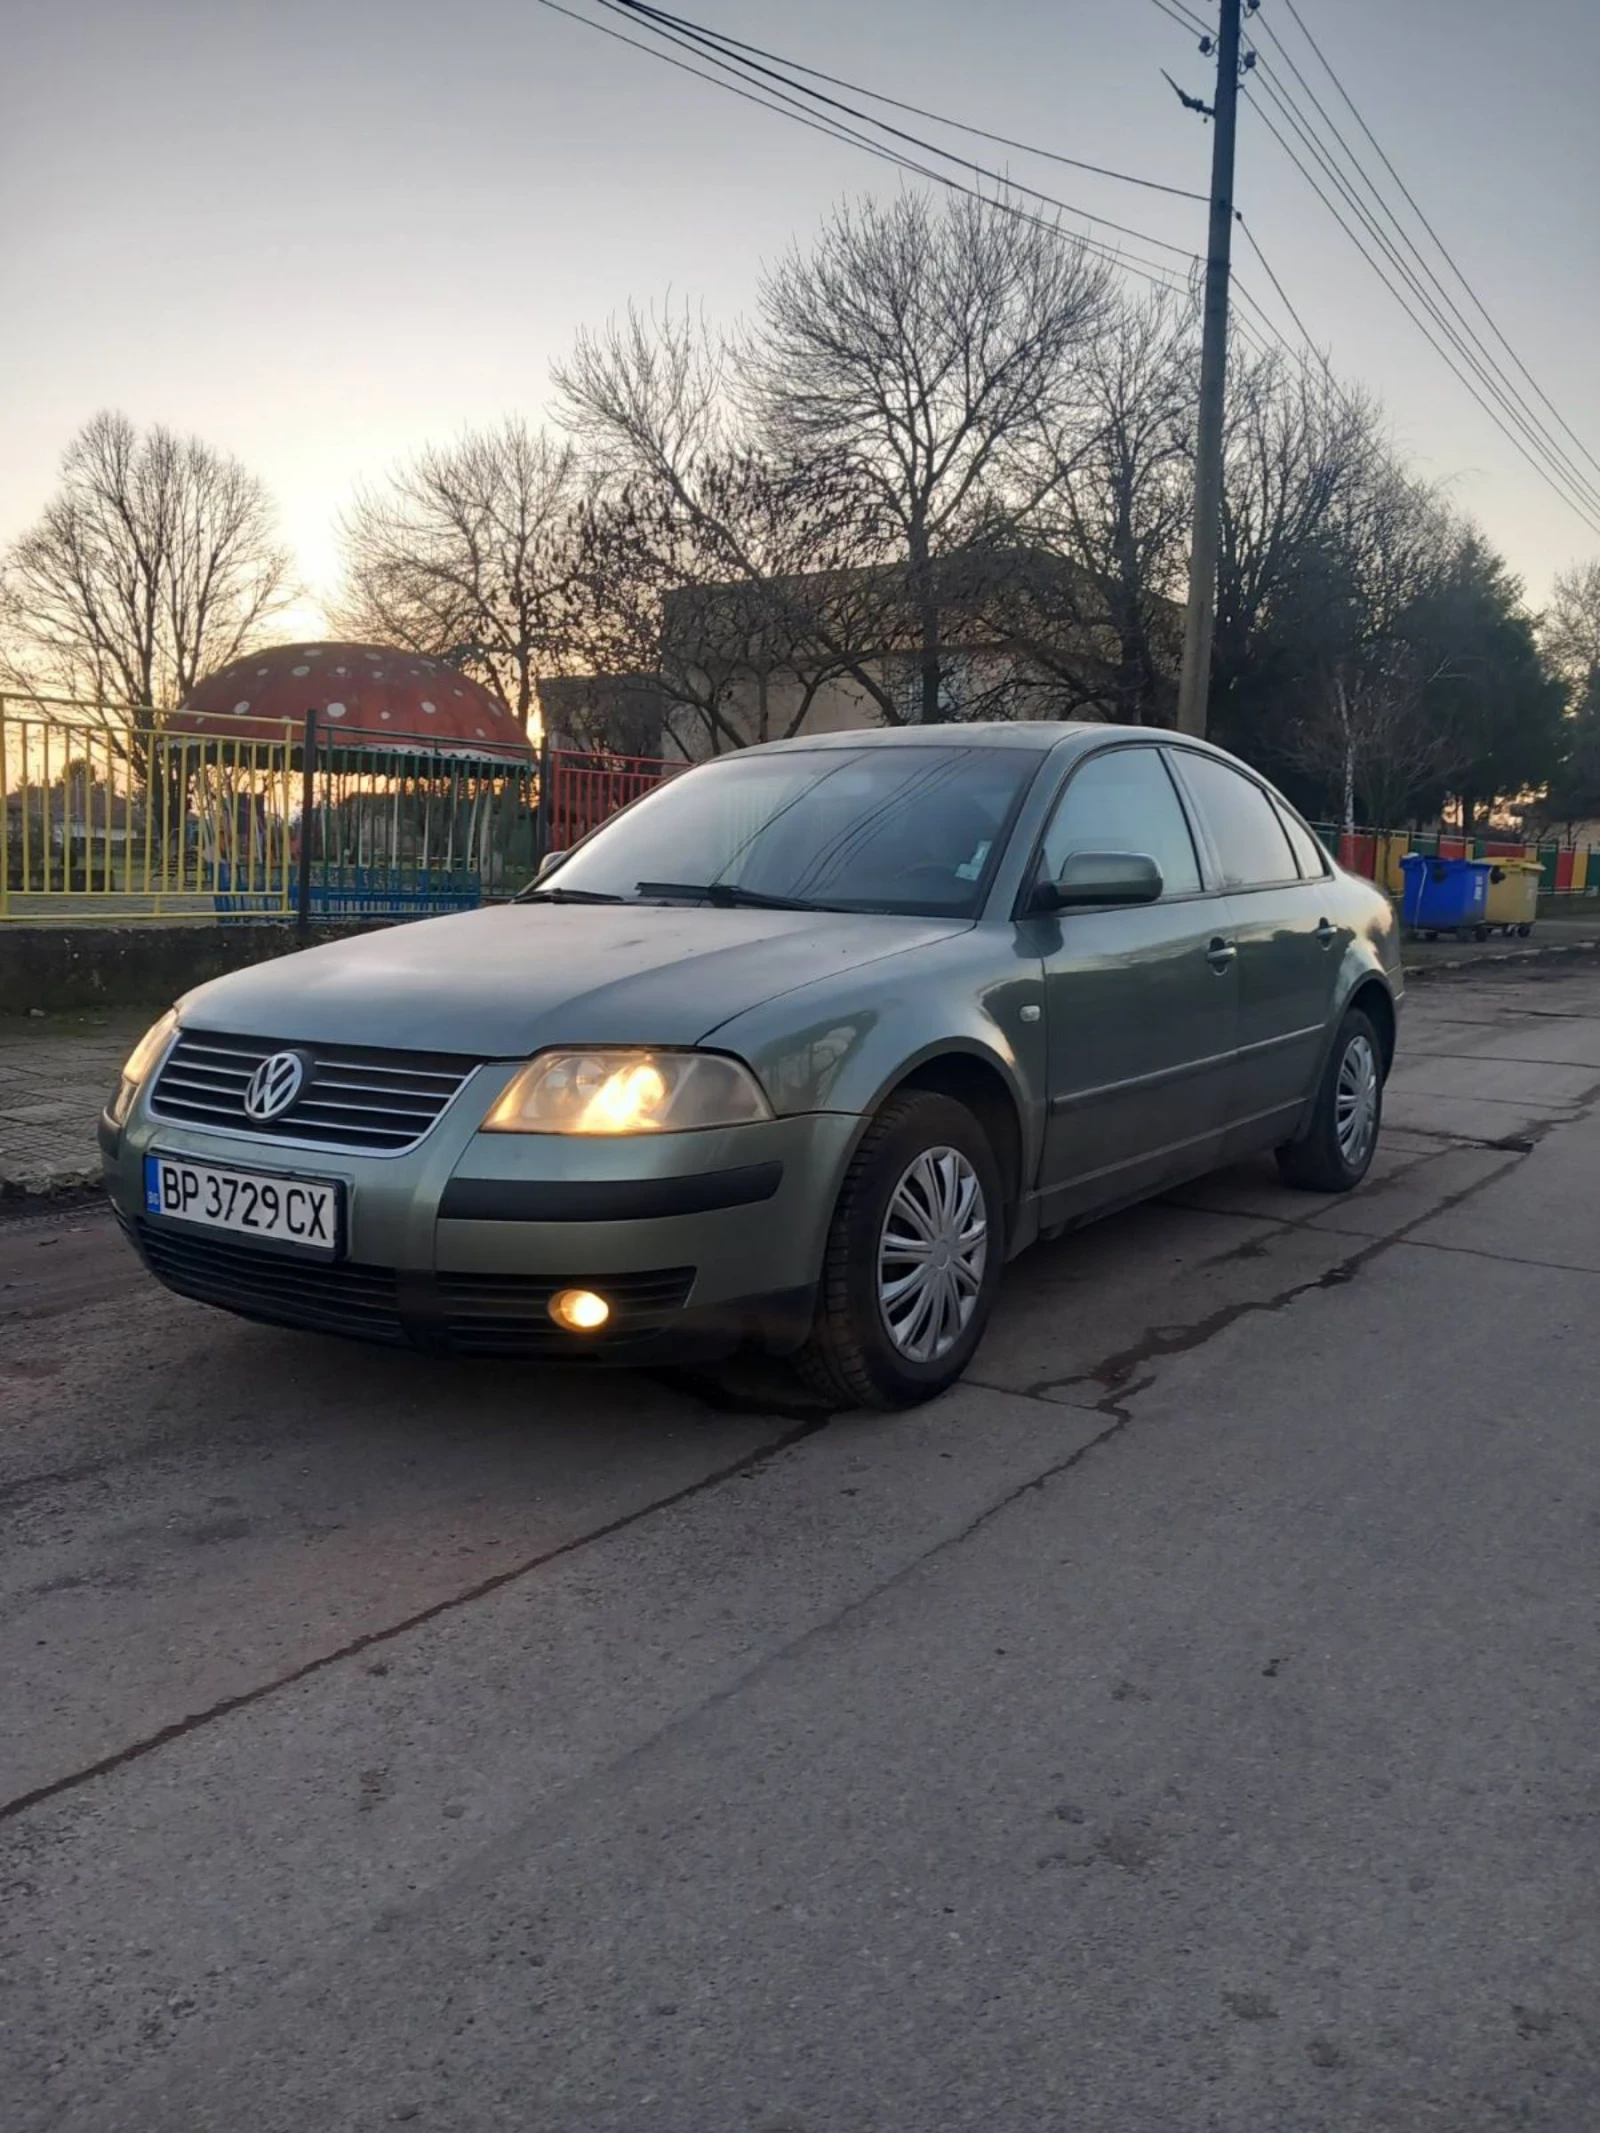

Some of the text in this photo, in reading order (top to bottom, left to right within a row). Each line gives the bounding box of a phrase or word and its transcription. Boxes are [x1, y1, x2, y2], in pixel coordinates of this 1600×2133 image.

[162, 1166, 327, 1240] BP 3729 CX
